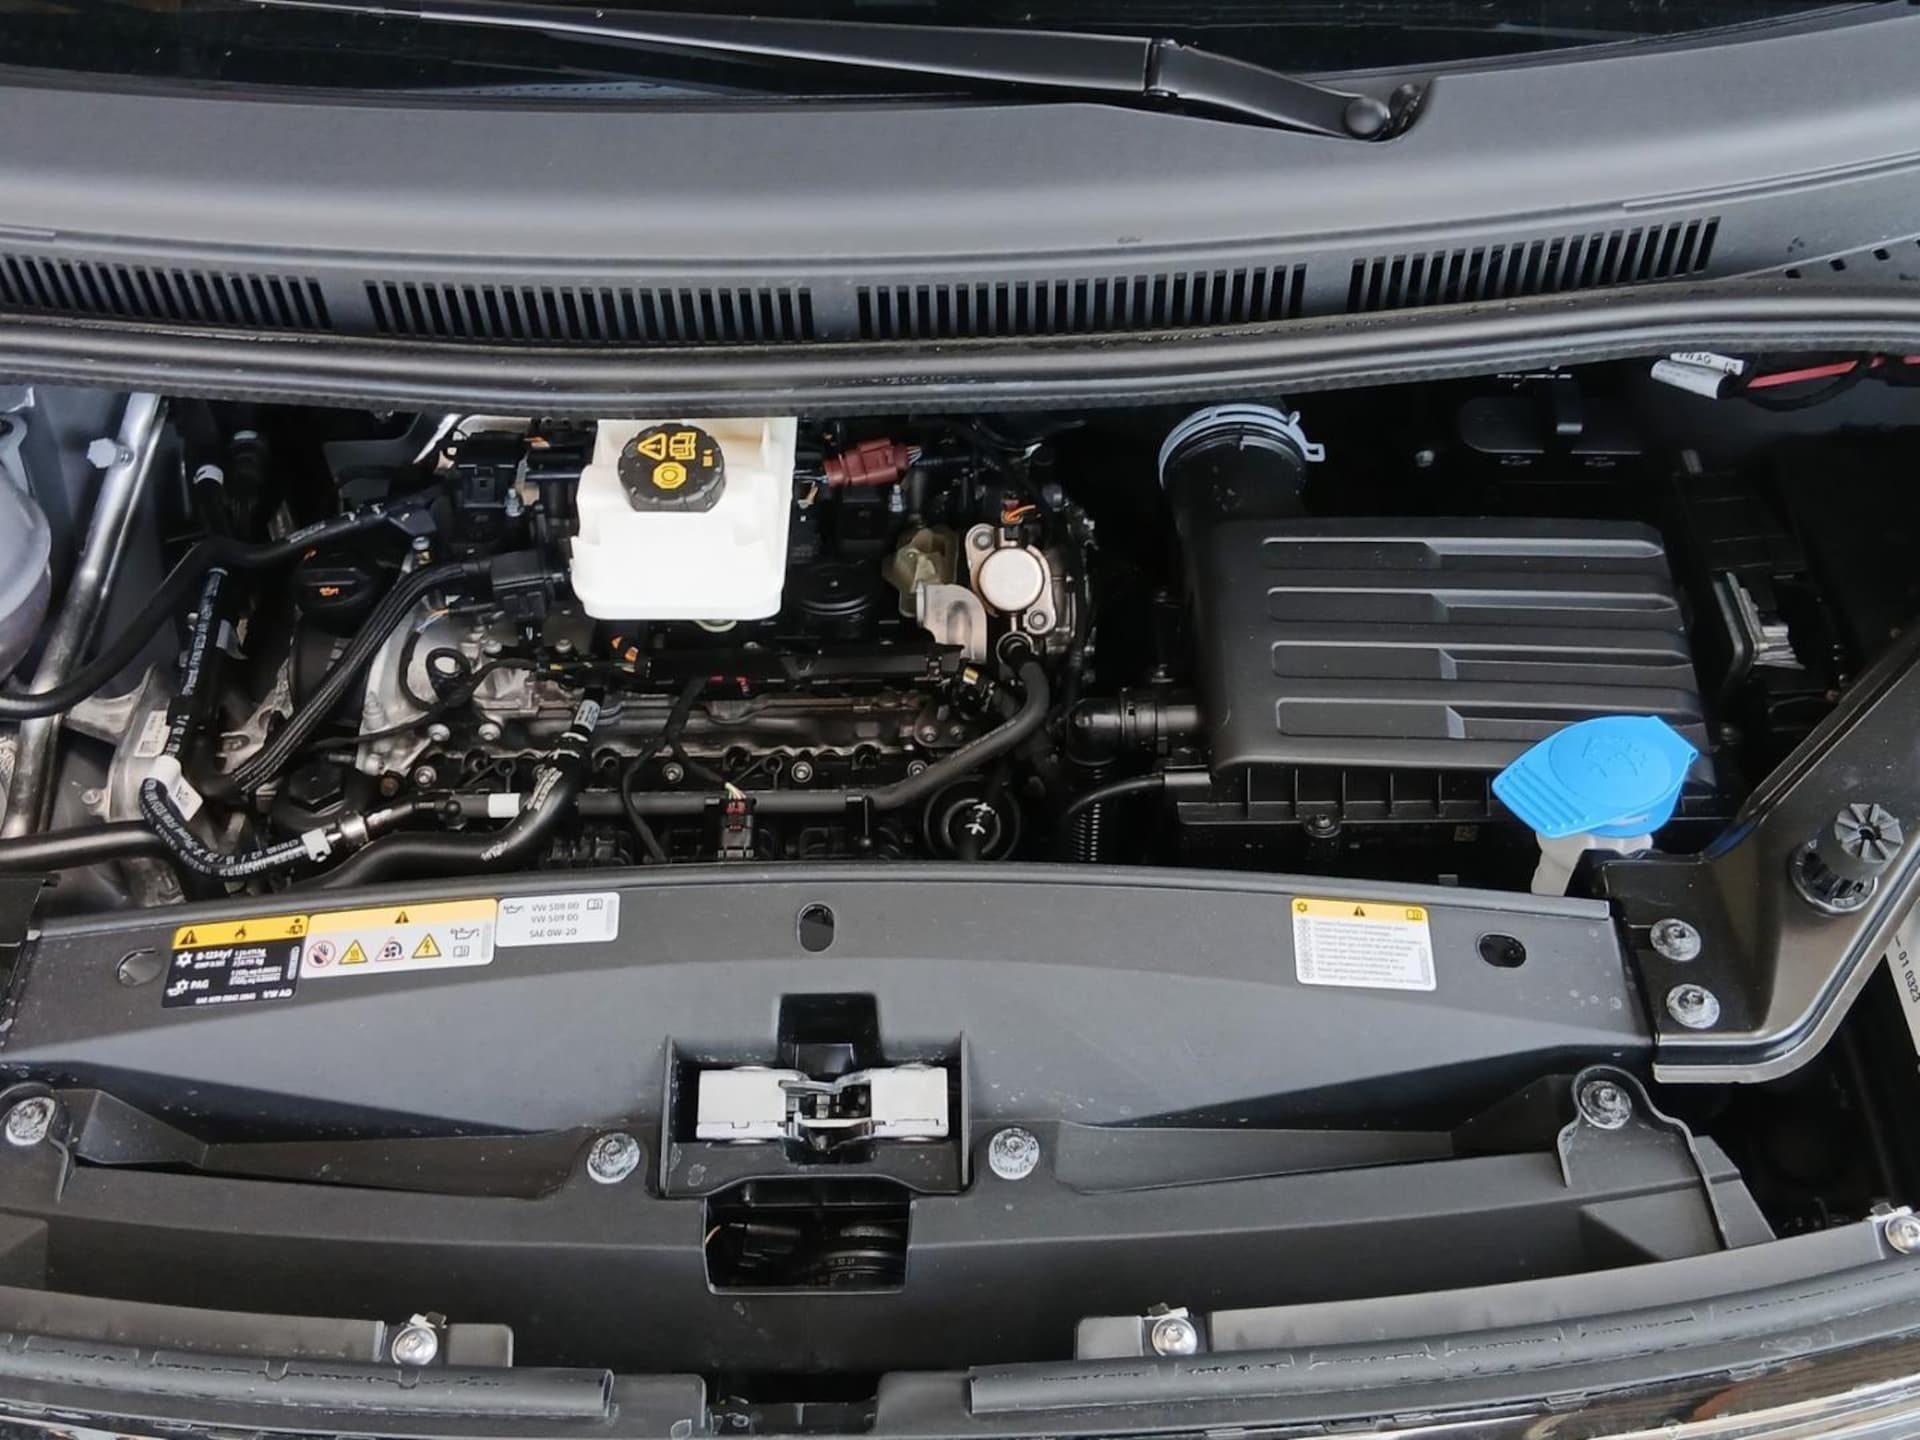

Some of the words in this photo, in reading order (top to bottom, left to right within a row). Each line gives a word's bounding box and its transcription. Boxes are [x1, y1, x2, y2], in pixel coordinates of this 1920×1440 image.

[531, 903, 547, 912] VW
[530, 915, 546, 924] VW
[566, 913, 579, 922] 00
[529, 929, 545, 938] SAE
[1898, 950, 1910, 968] 01
[262, 989, 279, 999] VW
